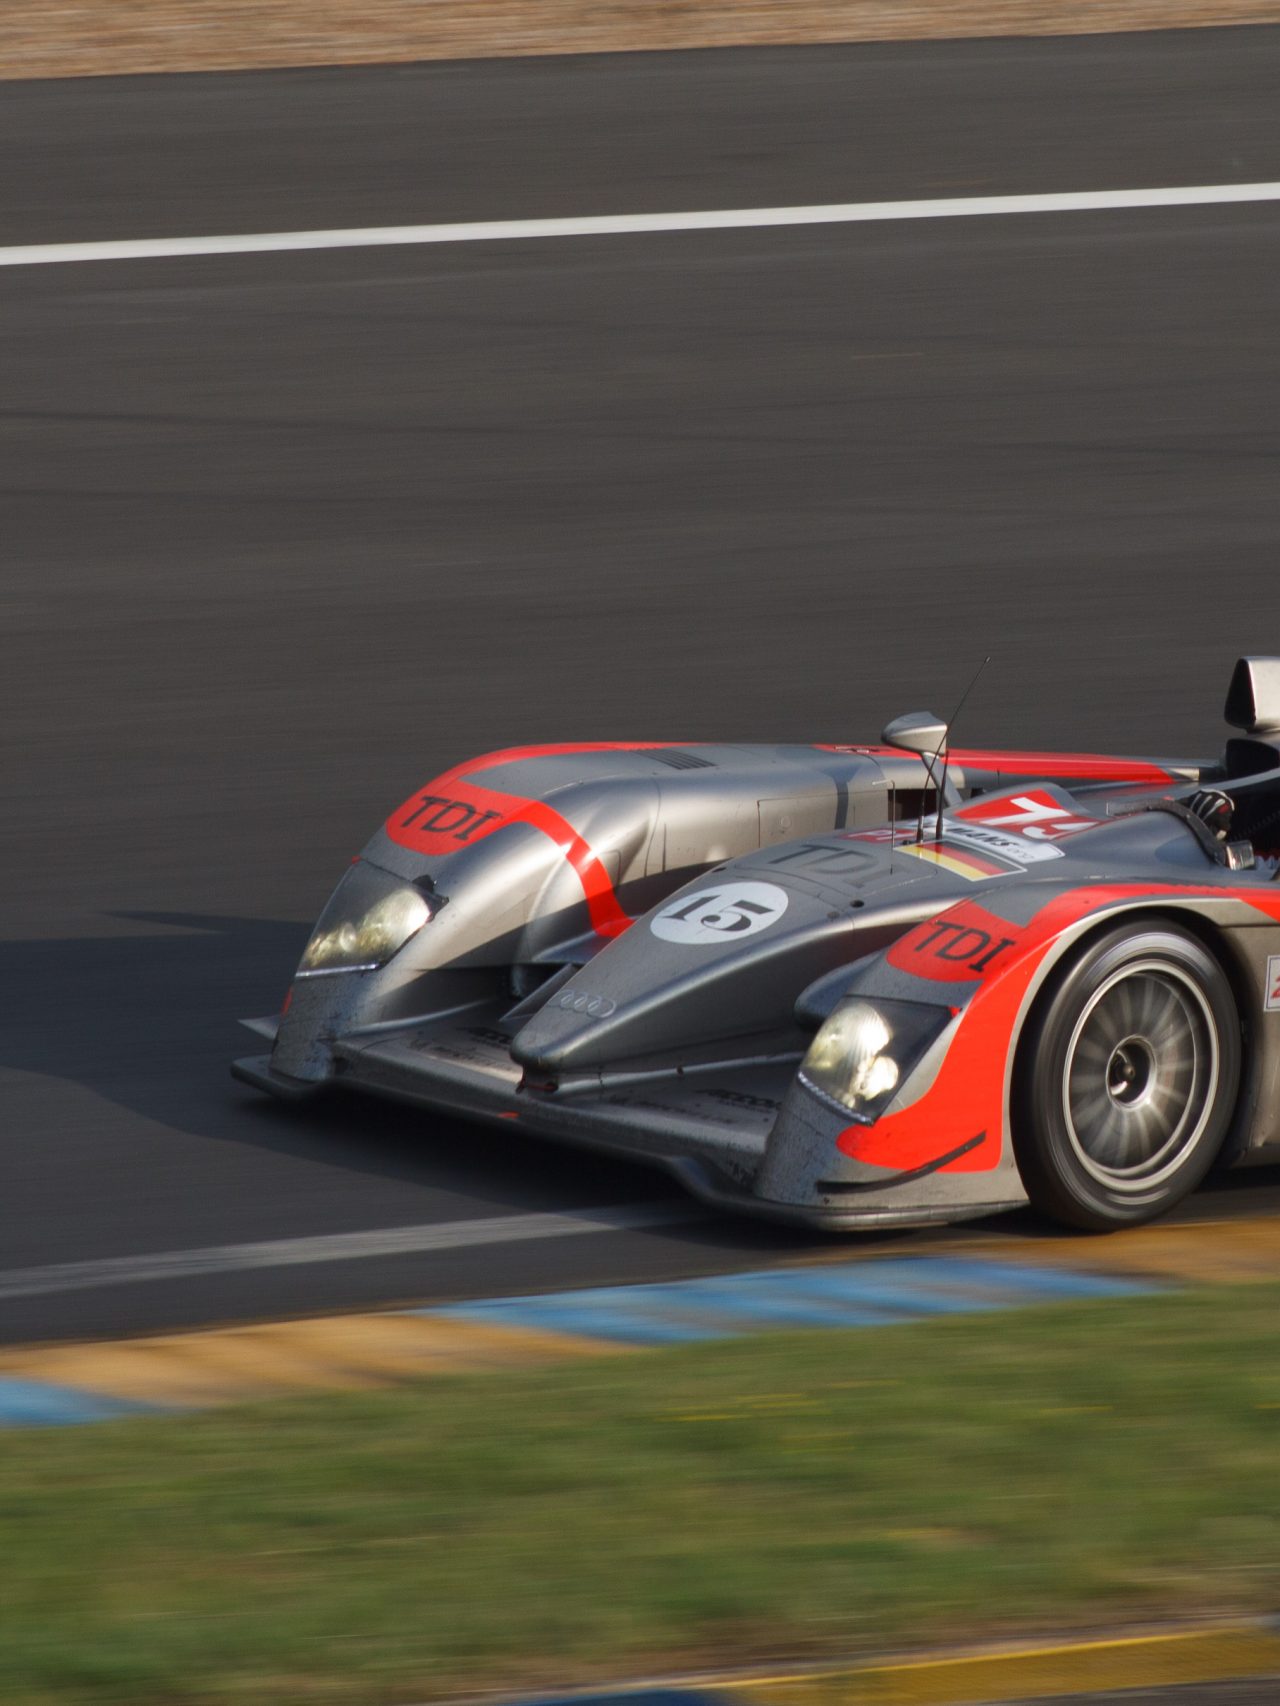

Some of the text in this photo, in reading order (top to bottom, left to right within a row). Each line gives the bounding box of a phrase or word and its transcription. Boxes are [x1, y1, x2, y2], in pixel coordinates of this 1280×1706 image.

[401, 795, 502, 840] TDI
[662, 894, 775, 932] 15
[915, 921, 1016, 972] TDI
